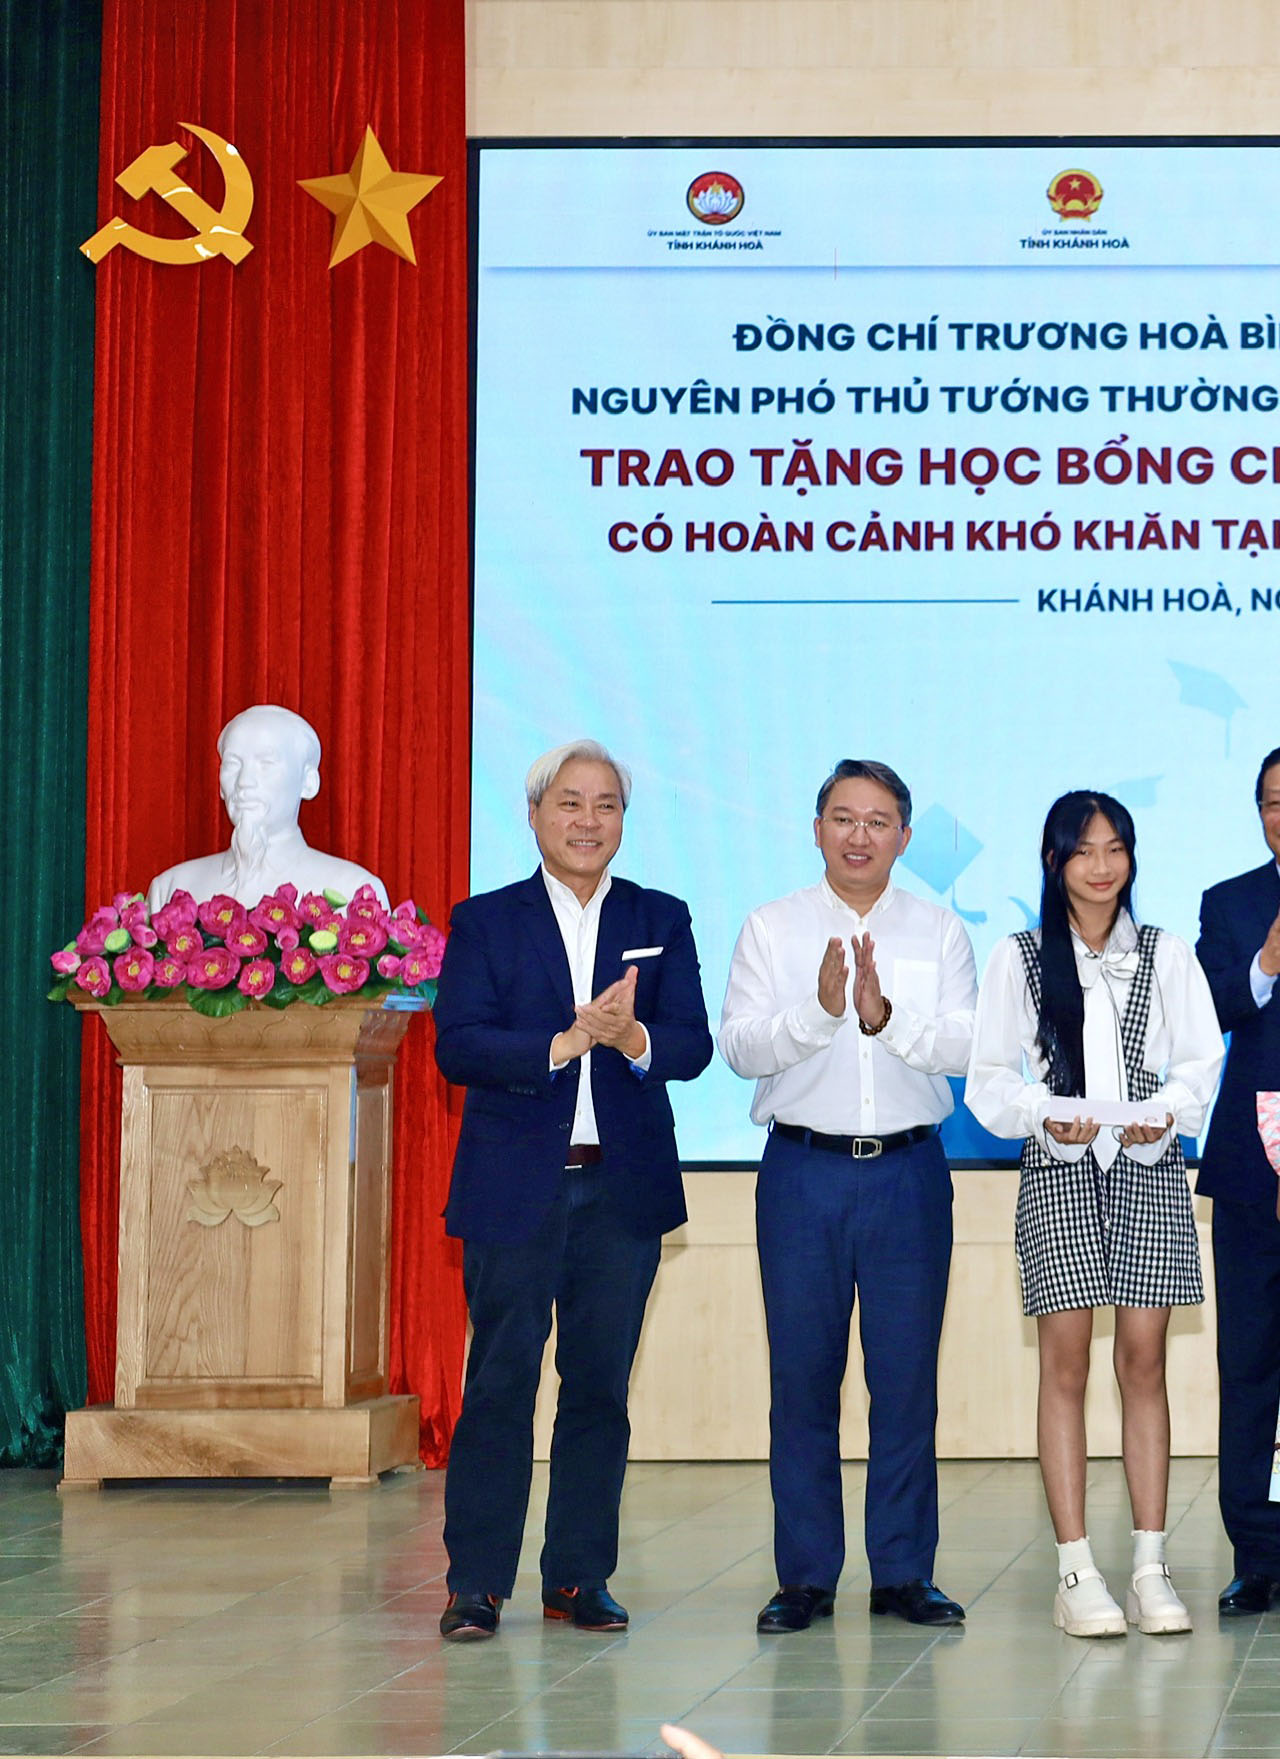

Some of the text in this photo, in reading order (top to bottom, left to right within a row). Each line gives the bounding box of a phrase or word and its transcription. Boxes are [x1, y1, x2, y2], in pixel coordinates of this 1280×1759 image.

[695, 239, 736, 250] KHÁNH
[1053, 237, 1099, 249] KHÁNH
[1101, 237, 1130, 249] HOÀ
[732, 315, 855, 352] ĐỒNG
[867, 315, 939, 351] CHÍ
[948, 322, 1128, 351] TRƯƠNG
[1140, 314, 1228, 350] HOÀ
[572, 379, 740, 415] NGUYÊN
[752, 378, 835, 414] PHÓ
[846, 377, 928, 414] THỦ
[940, 378, 1089, 413] TƯỚNG
[1100, 377, 1278, 412] THƯỜNG
[580, 448, 734, 487] TRAO
[750, 439, 903, 496] TẶNG
[920, 447, 1040, 496] HỌC
[1058, 434, 1214, 485] BỔNG
[608, 513, 673, 553] CÓ
[686, 512, 813, 552] HOÀN
[826, 511, 954, 552] CẢNH
[967, 511, 1061, 551] KHÓ
[1074, 512, 1200, 550] KHĂN
[1212, 519, 1280, 558] TẠI
[1038, 582, 1152, 612] KHÁNH
[1164, 582, 1241, 616] HOÀ,
